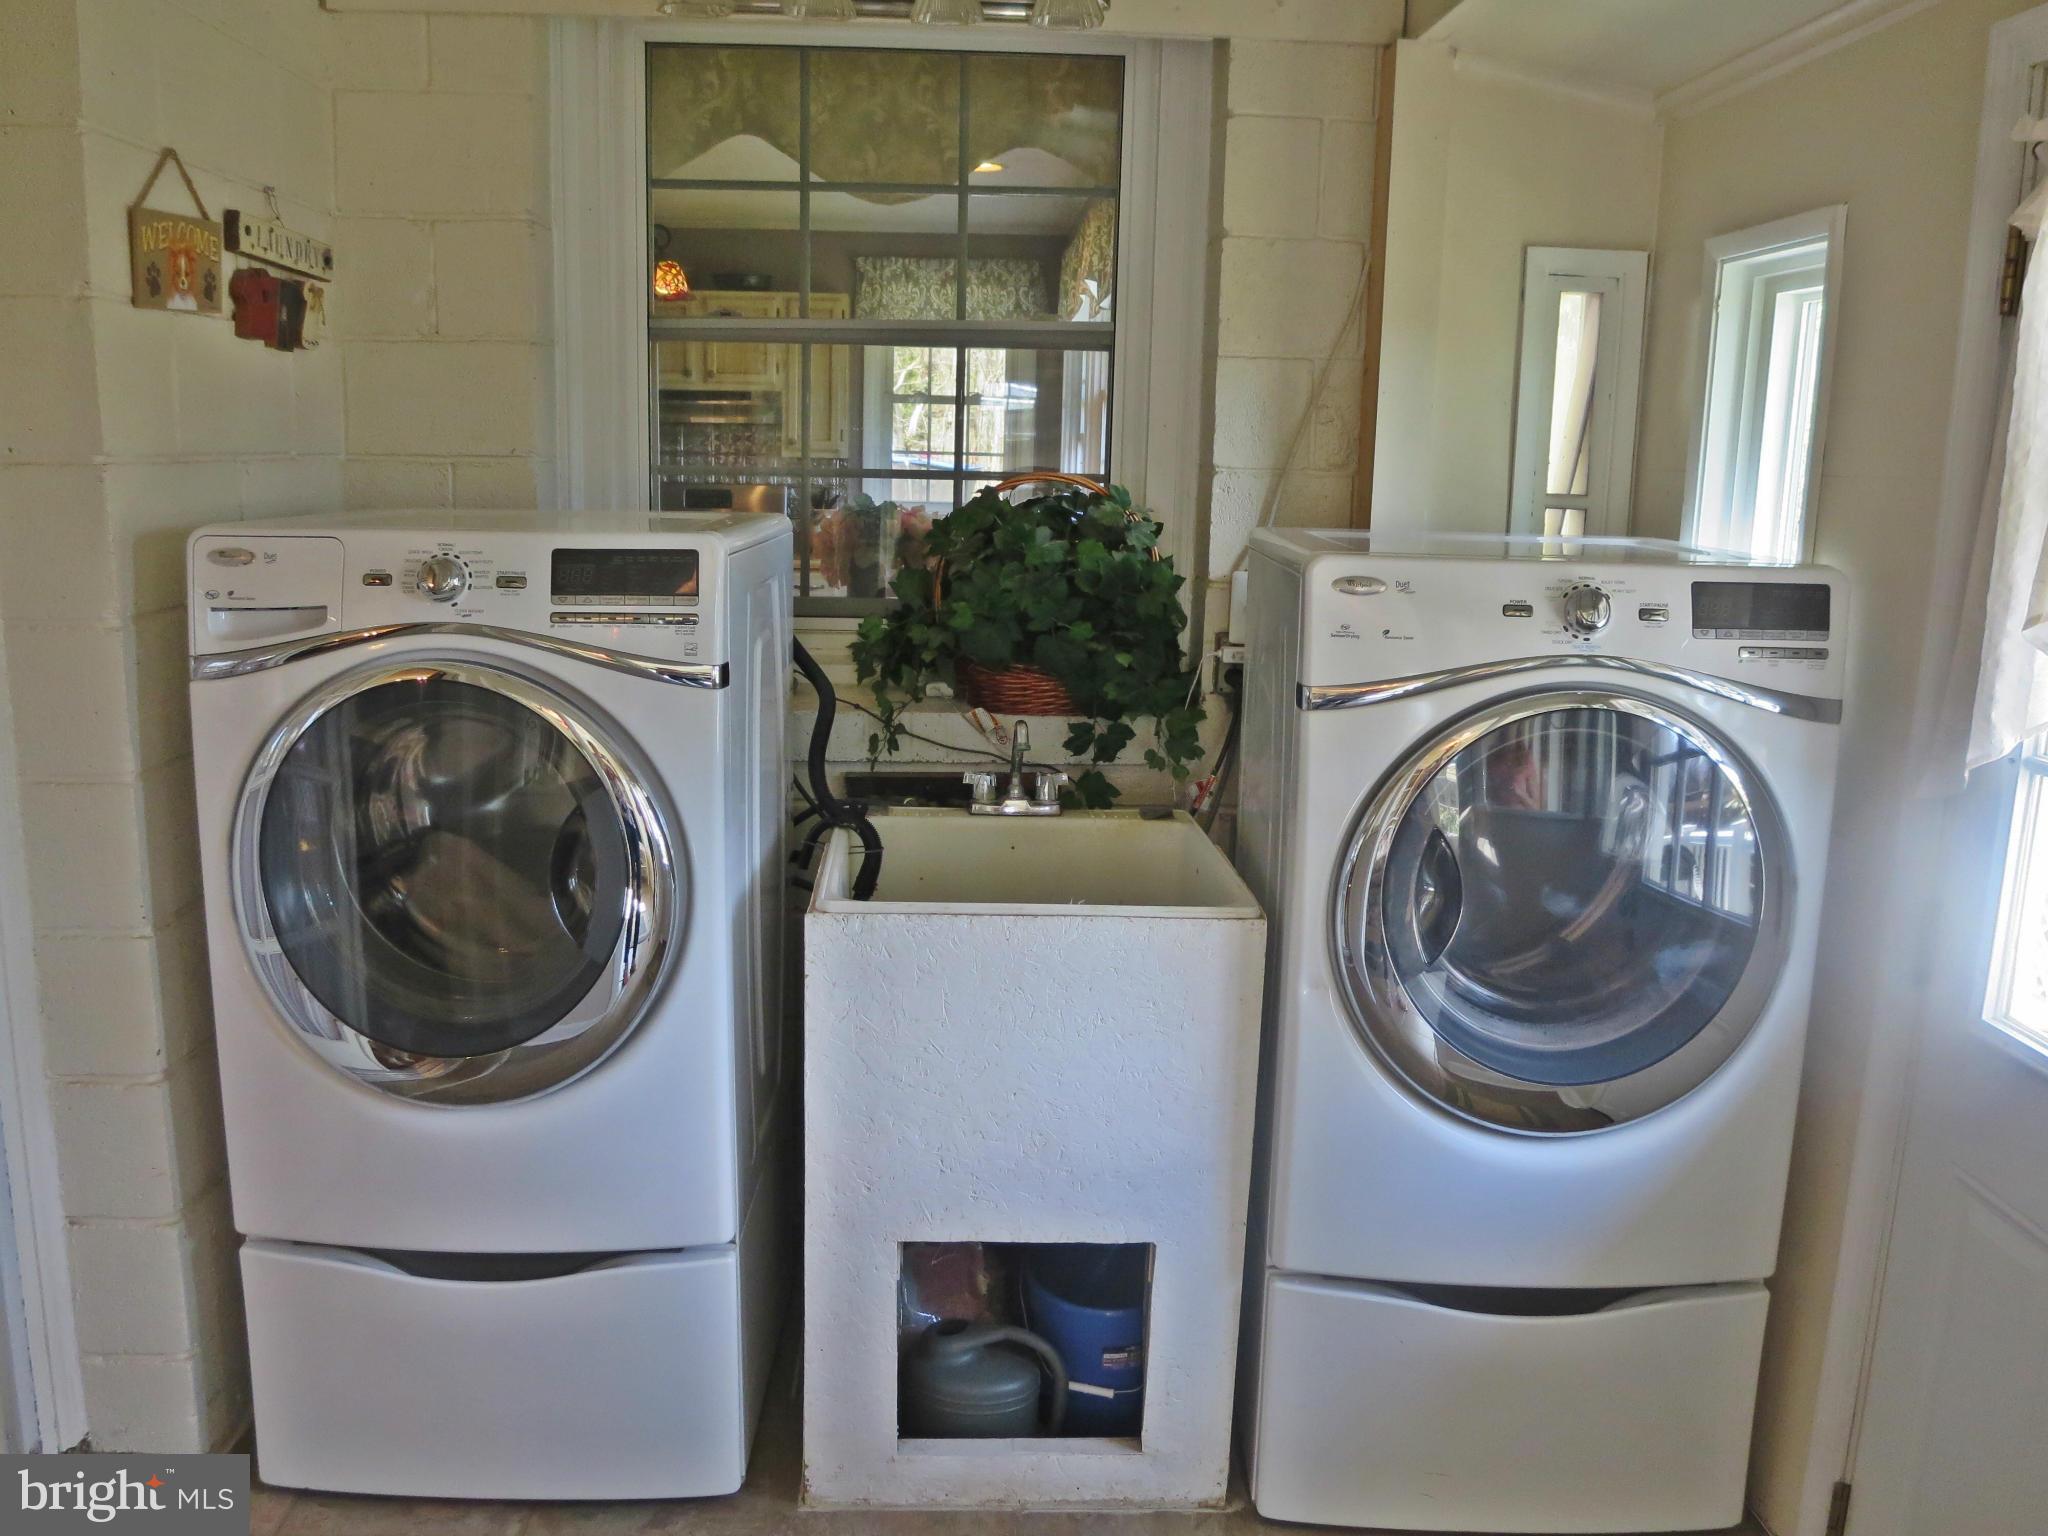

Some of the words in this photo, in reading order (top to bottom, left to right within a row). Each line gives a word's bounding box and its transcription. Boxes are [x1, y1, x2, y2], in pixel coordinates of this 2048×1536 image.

[140, 221, 220, 262] WELCOME
[255, 224, 319, 269] LAUNDRY
[1395, 580, 1411, 589] Duet
